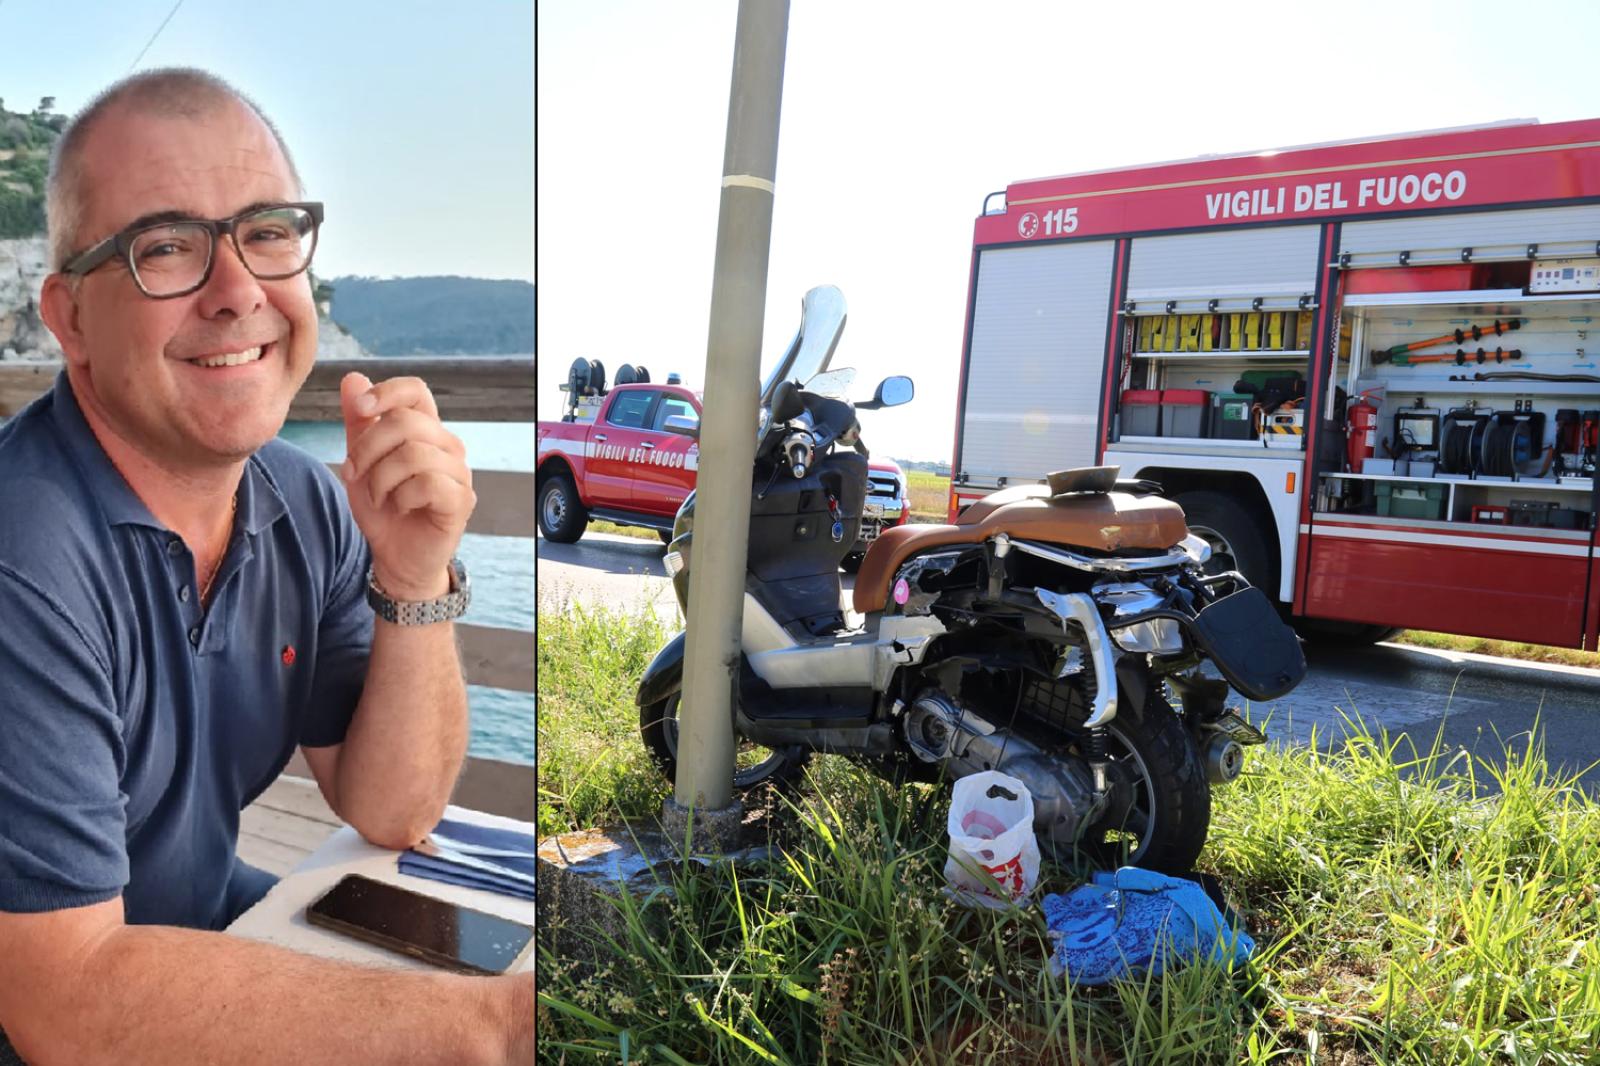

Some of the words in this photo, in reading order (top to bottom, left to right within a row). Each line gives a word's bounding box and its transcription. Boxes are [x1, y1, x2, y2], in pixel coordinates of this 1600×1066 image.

[1205, 186, 1286, 219] VIGILI
[1293, 181, 1348, 212] DEL
[1358, 170, 1467, 207] FUOCO
[1042, 207, 1079, 236] 115
[595, 443, 627, 461] VIGILI
[628, 447, 647, 464] DEL
[648, 450, 685, 469] FUOCO
